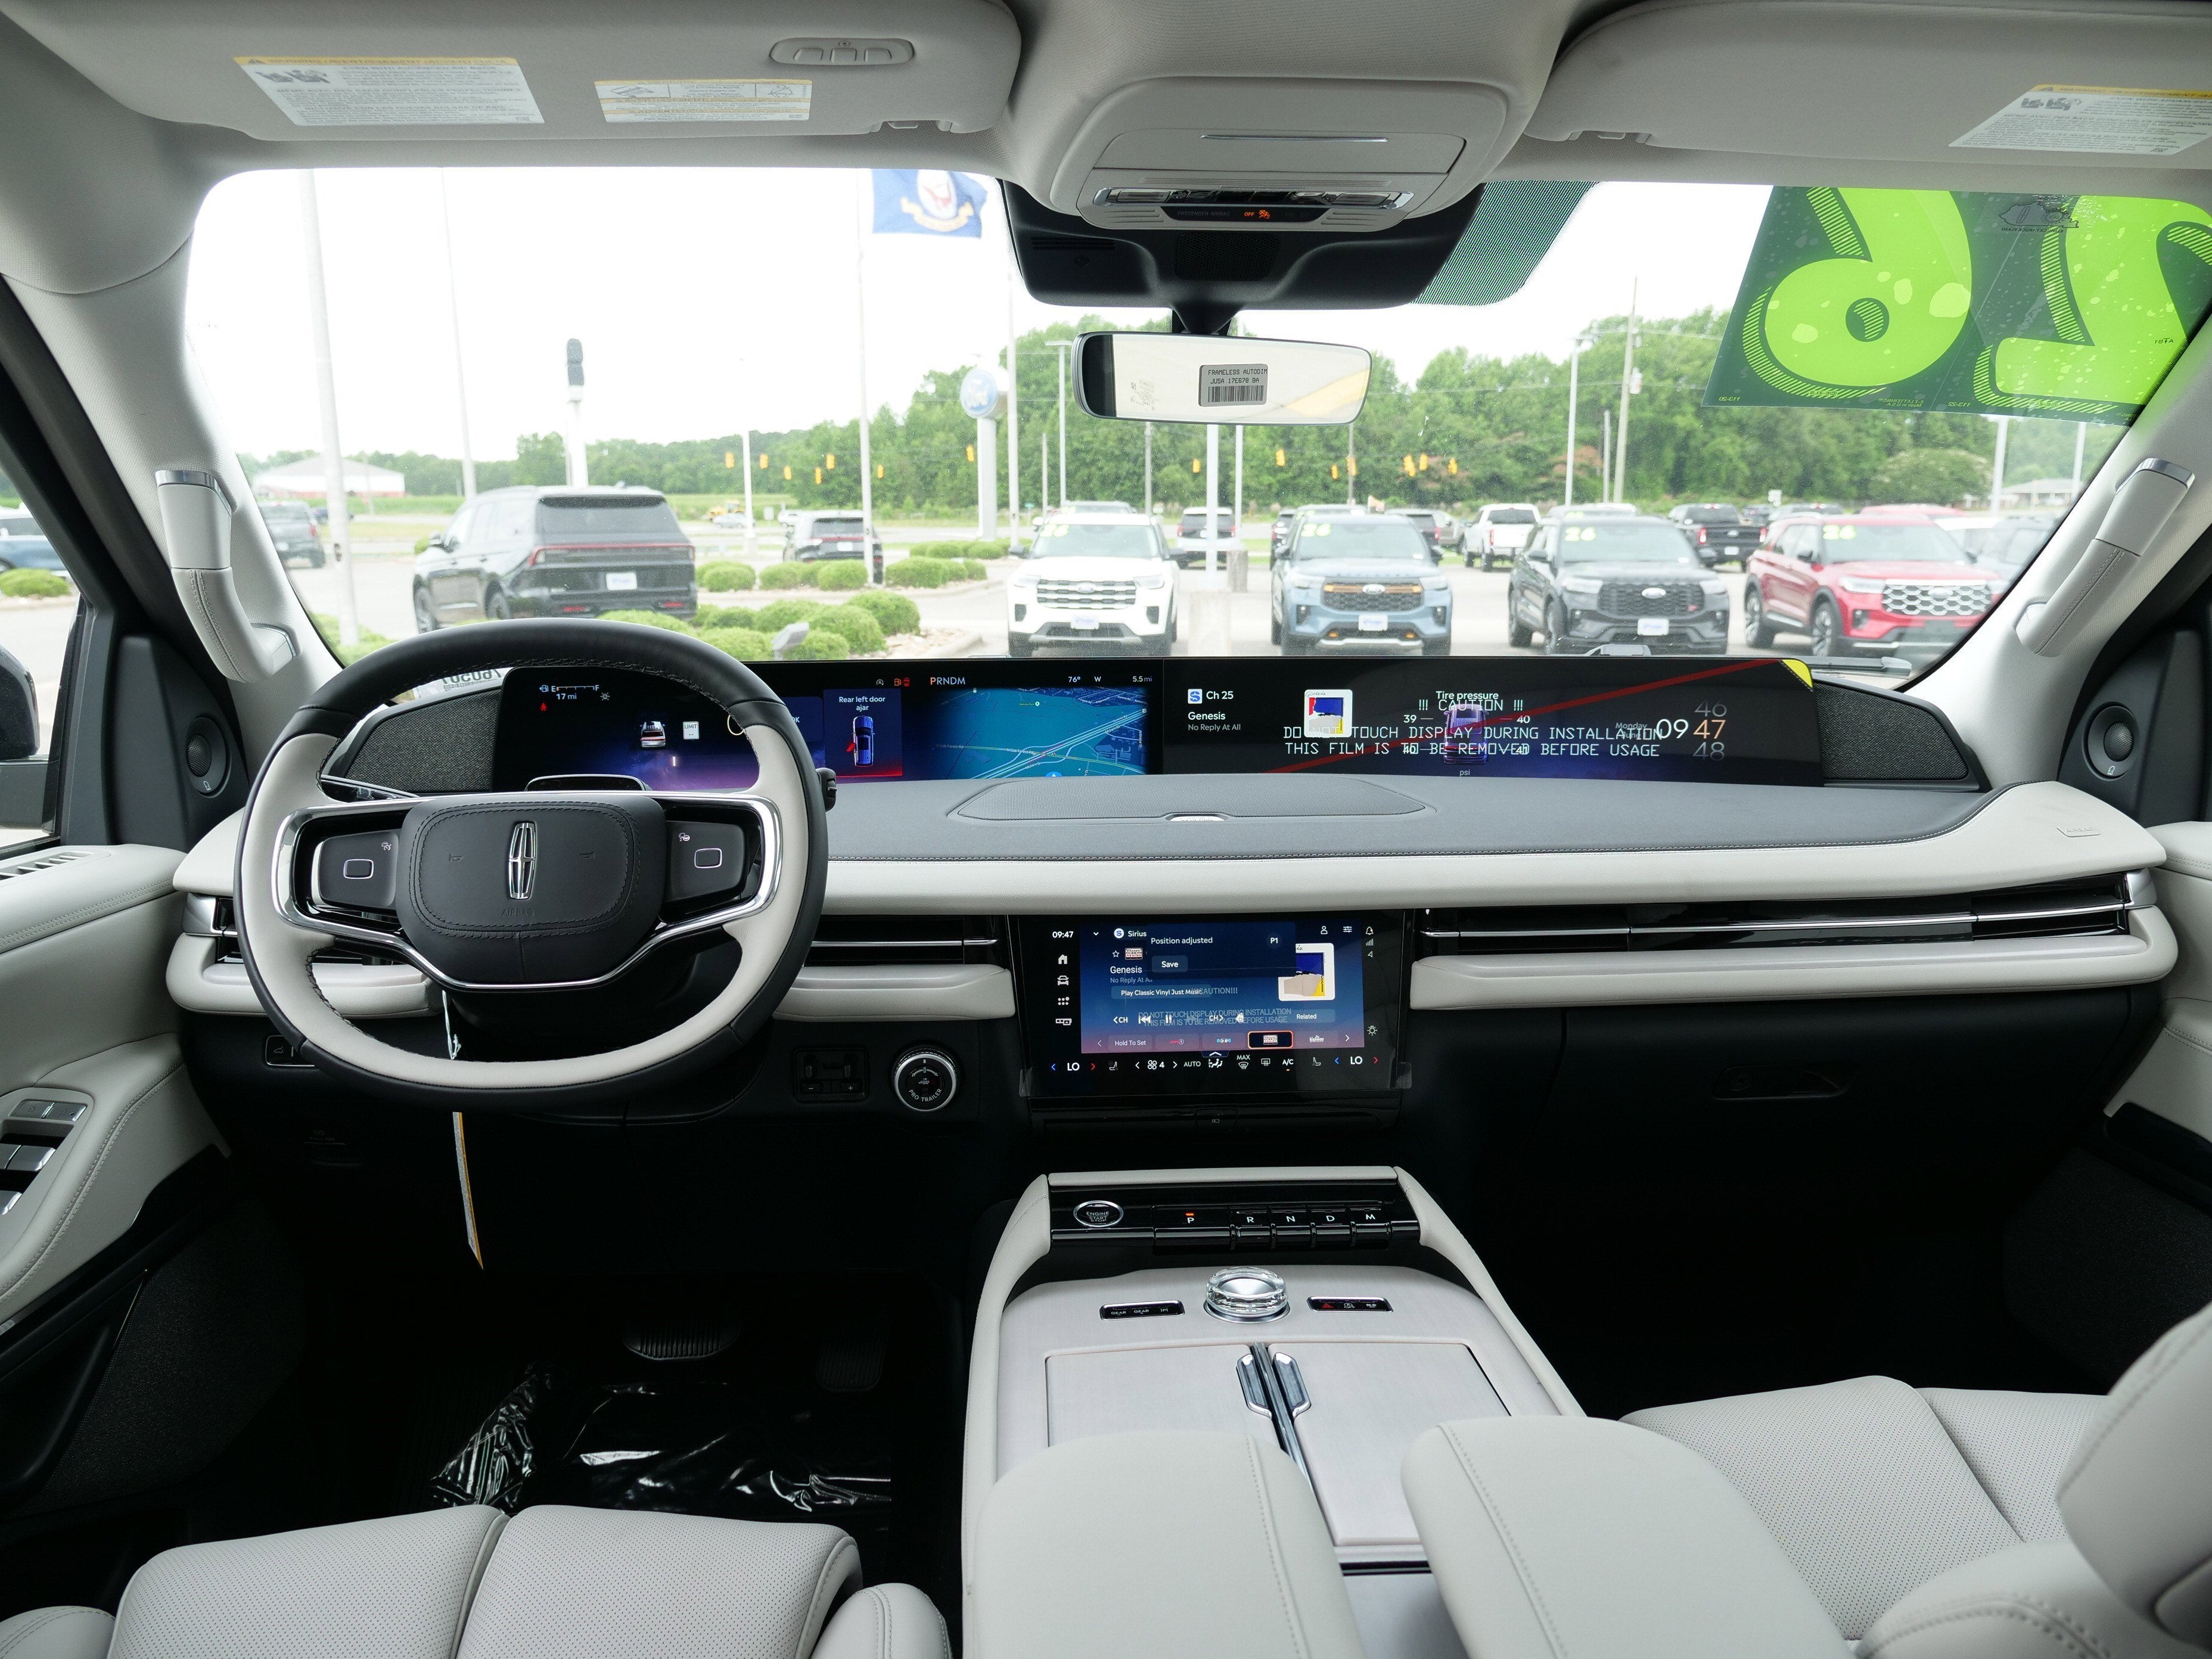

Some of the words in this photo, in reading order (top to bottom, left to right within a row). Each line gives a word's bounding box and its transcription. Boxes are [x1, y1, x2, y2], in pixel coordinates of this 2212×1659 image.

[1565, 527, 1596, 541] 26
[1823, 525, 1856, 540] 26
[930, 677, 965, 685] PRNDM
[1206, 691, 1219, 699] Ch
[1457, 692, 1499, 701] pressure
[1439, 700, 1503, 711] CAUTION
[1694, 701, 1727, 717] 46
[1403, 714, 1416, 723] 39
[1200, 724, 1220, 732] Reply
[1284, 726, 1301, 738] DO
[1312, 727, 1340, 738] NOT
[1352, 726, 1399, 738] TOUCH
[1409, 726, 1473, 738] DISPLAY
[1484, 727, 1539, 739] DURING
[1549, 728, 1662, 740] INSTALLATION
[1657, 719, 1689, 739] 09
[1693, 719, 1726, 740] 47
[1285, 742, 1319, 754] THIS
[1329, 742, 1364, 754] FILM
[1375, 742, 1390, 754] IS
[1430, 742, 1447, 754] BE
[1459, 743, 1530, 755] REMOVED
[1540, 744, 1599, 756] BEFORE
[1610, 744, 1660, 756] USAGE
[1692, 741, 1725, 761] 48
[1459, 769, 1471, 777] psi
[1350, 1056, 1363, 1064] LO
[1067, 1062, 1080, 1071] LO
[909, 1089, 919, 1100] PRO
[921, 1088, 942, 1102] TRAILER
